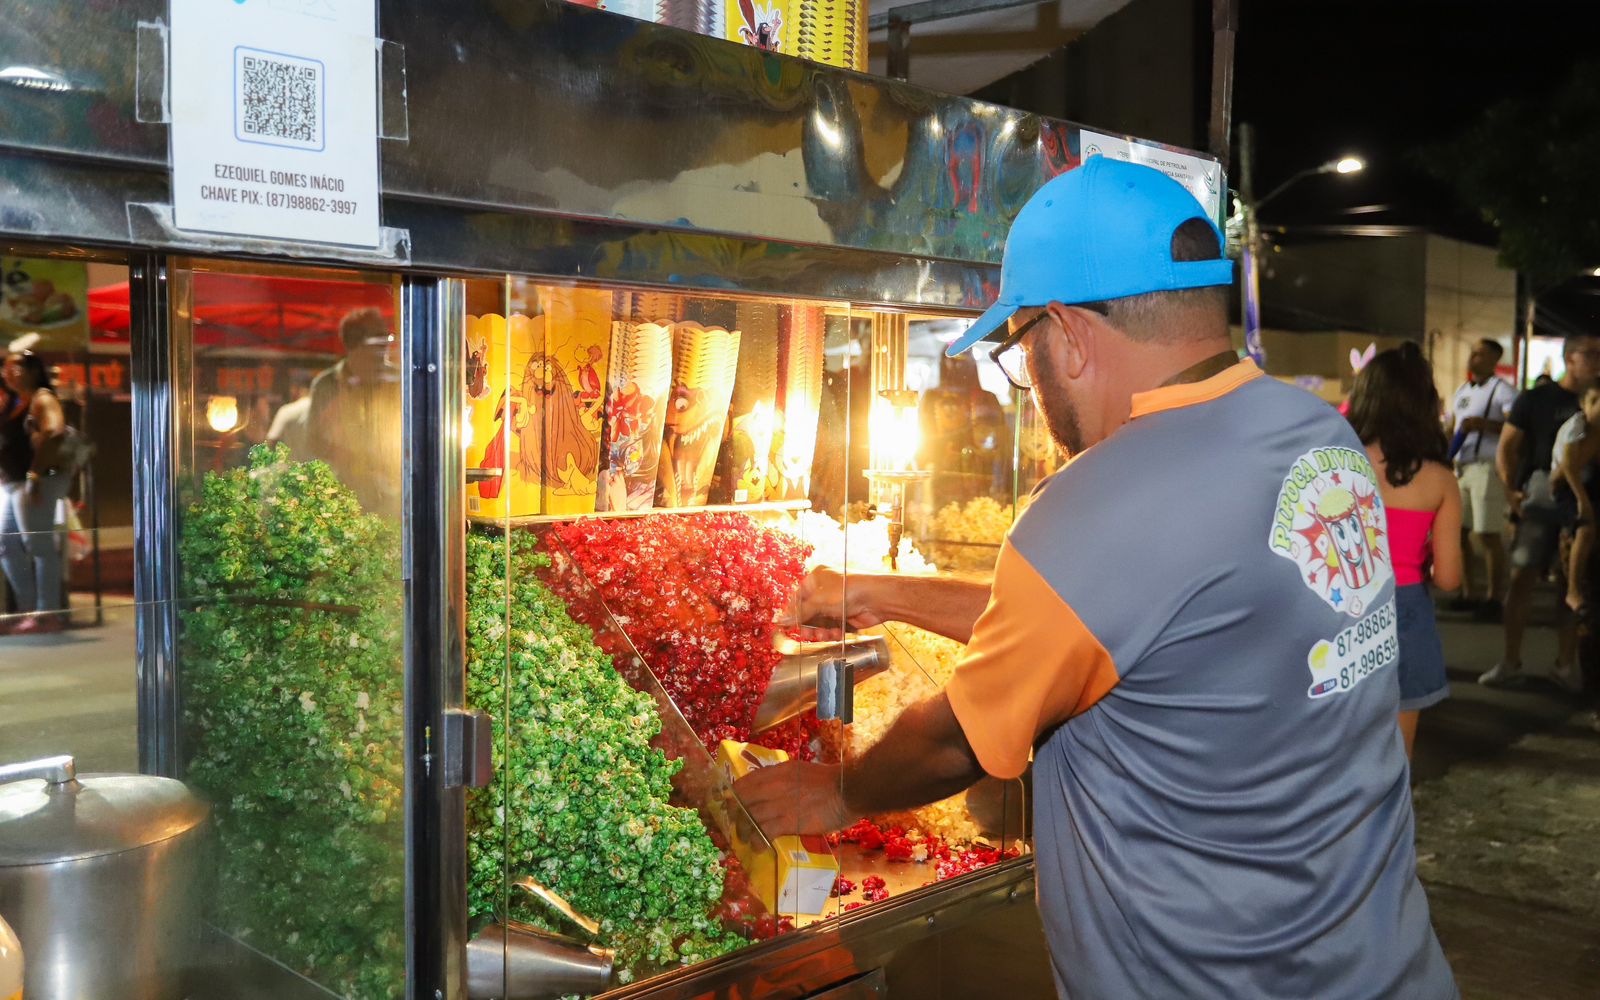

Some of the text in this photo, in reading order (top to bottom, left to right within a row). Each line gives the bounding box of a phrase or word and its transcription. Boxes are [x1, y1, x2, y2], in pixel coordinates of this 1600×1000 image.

[214, 163, 344, 192] EZEQUIEL GOMES INÁCIO
[201, 185, 238, 202] CHAVE
[241, 190, 263, 205] PIX:
[1273, 458, 1318, 550] PIPOCA
